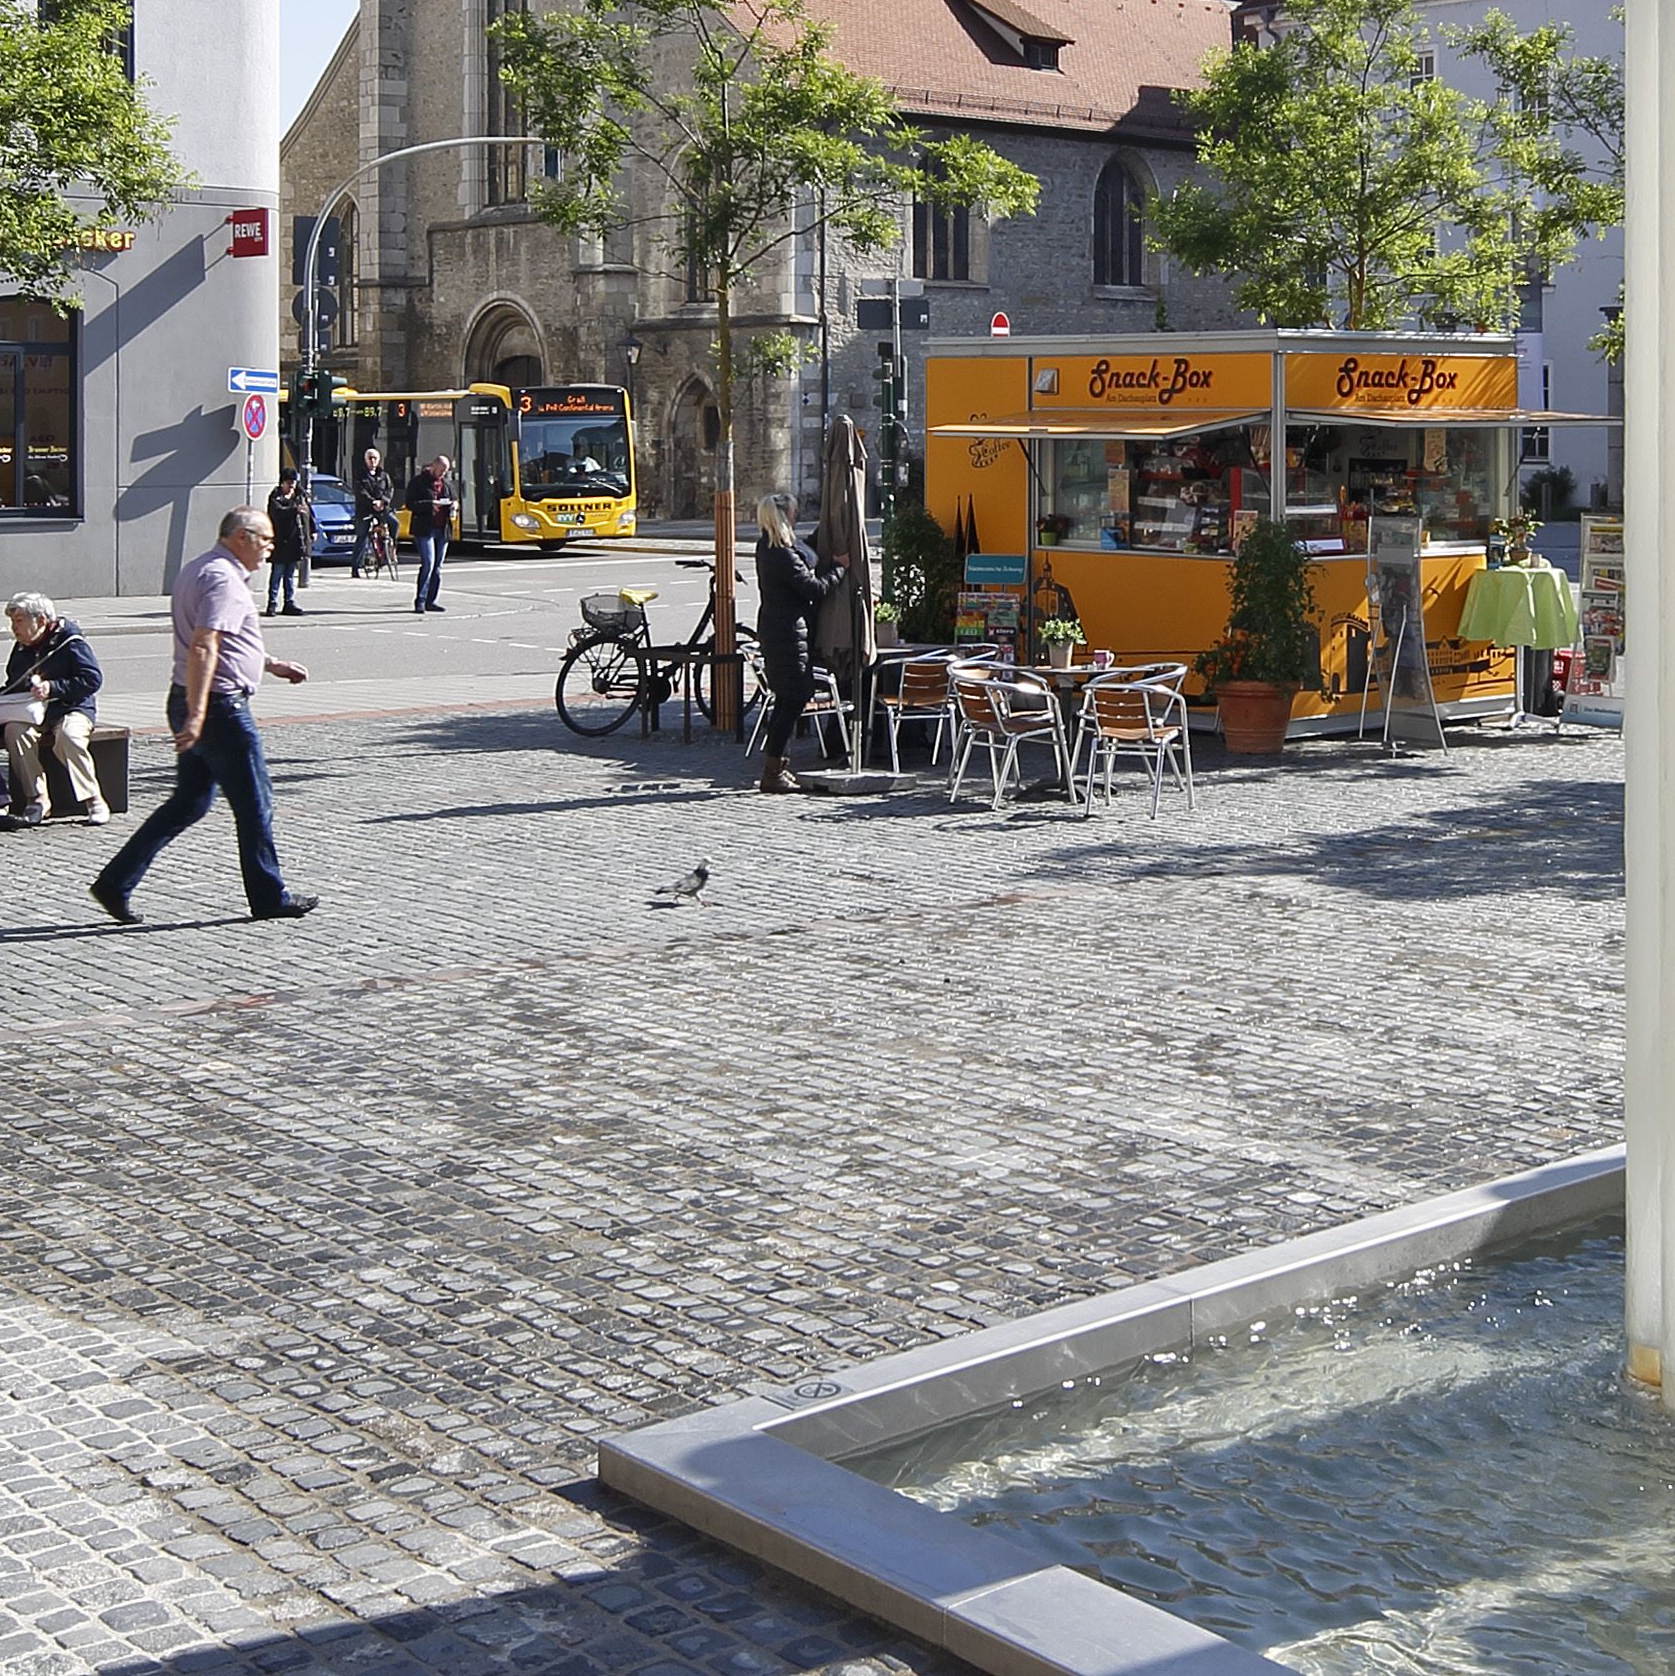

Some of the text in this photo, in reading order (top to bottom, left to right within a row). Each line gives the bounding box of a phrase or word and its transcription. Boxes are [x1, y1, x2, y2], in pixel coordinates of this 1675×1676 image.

[234, 223, 261, 238] REWE
[1089, 358, 1213, 404] Snack-Box
[1337, 358, 1458, 404] Snack-Box
[398, 403, 405, 417] 3
[519, 395, 532, 413] 3
